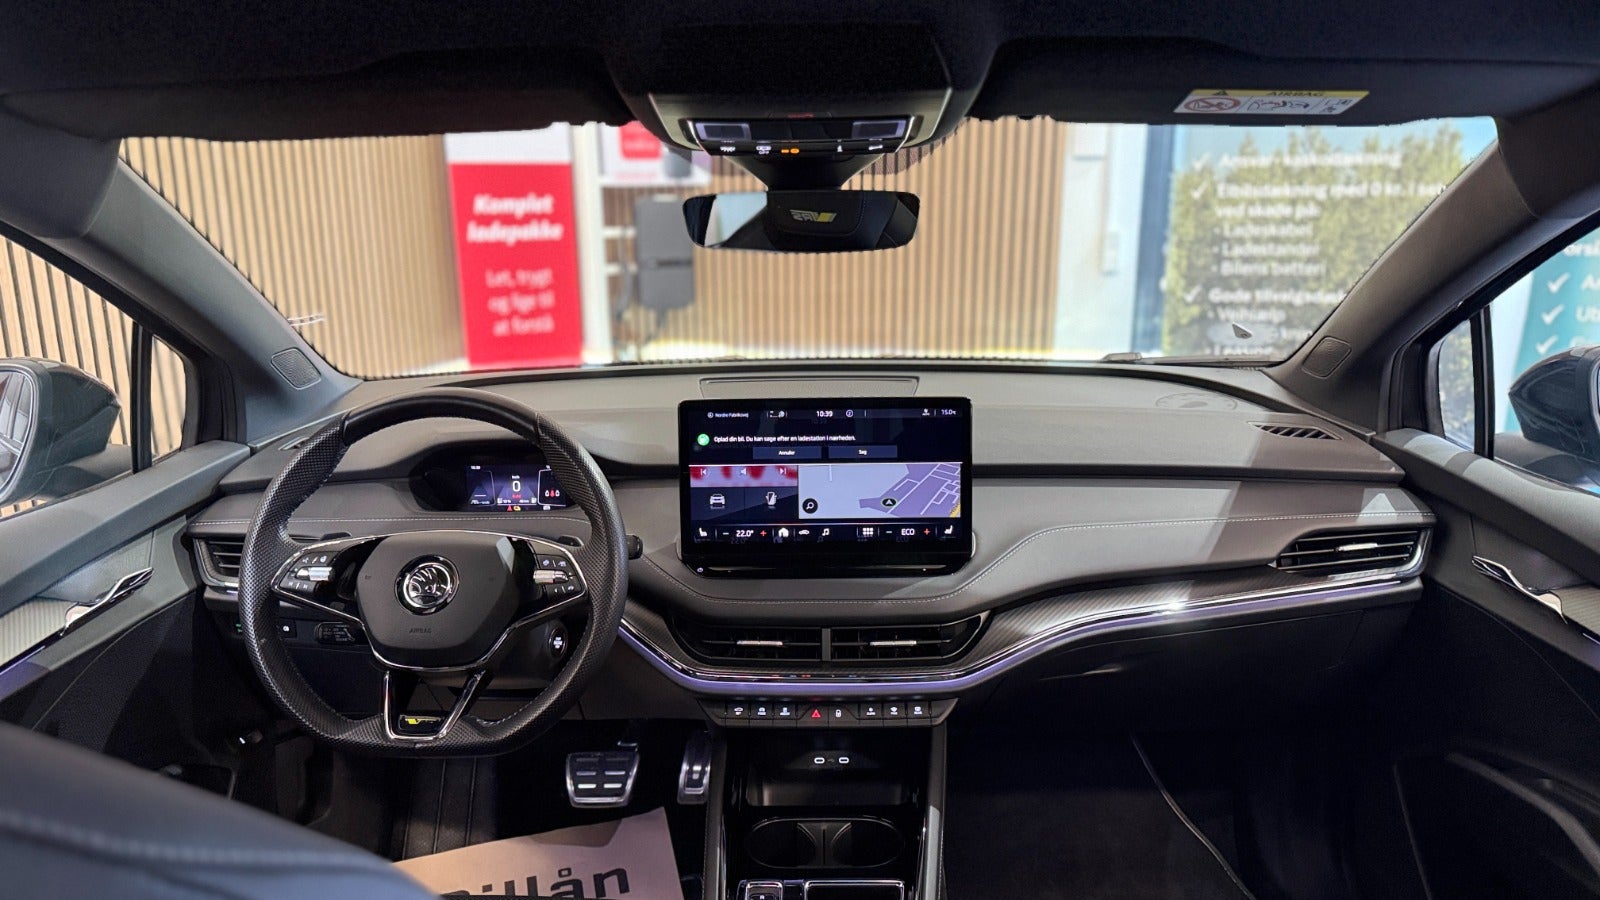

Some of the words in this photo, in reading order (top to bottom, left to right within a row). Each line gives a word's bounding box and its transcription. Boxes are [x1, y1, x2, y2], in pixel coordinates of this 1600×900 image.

[473, 194, 554, 218] Komplet
[816, 410, 834, 418] 10:39
[512, 480, 521, 492] 0
[901, 528, 915, 536] ECO
[440, 867, 631, 900] llån
